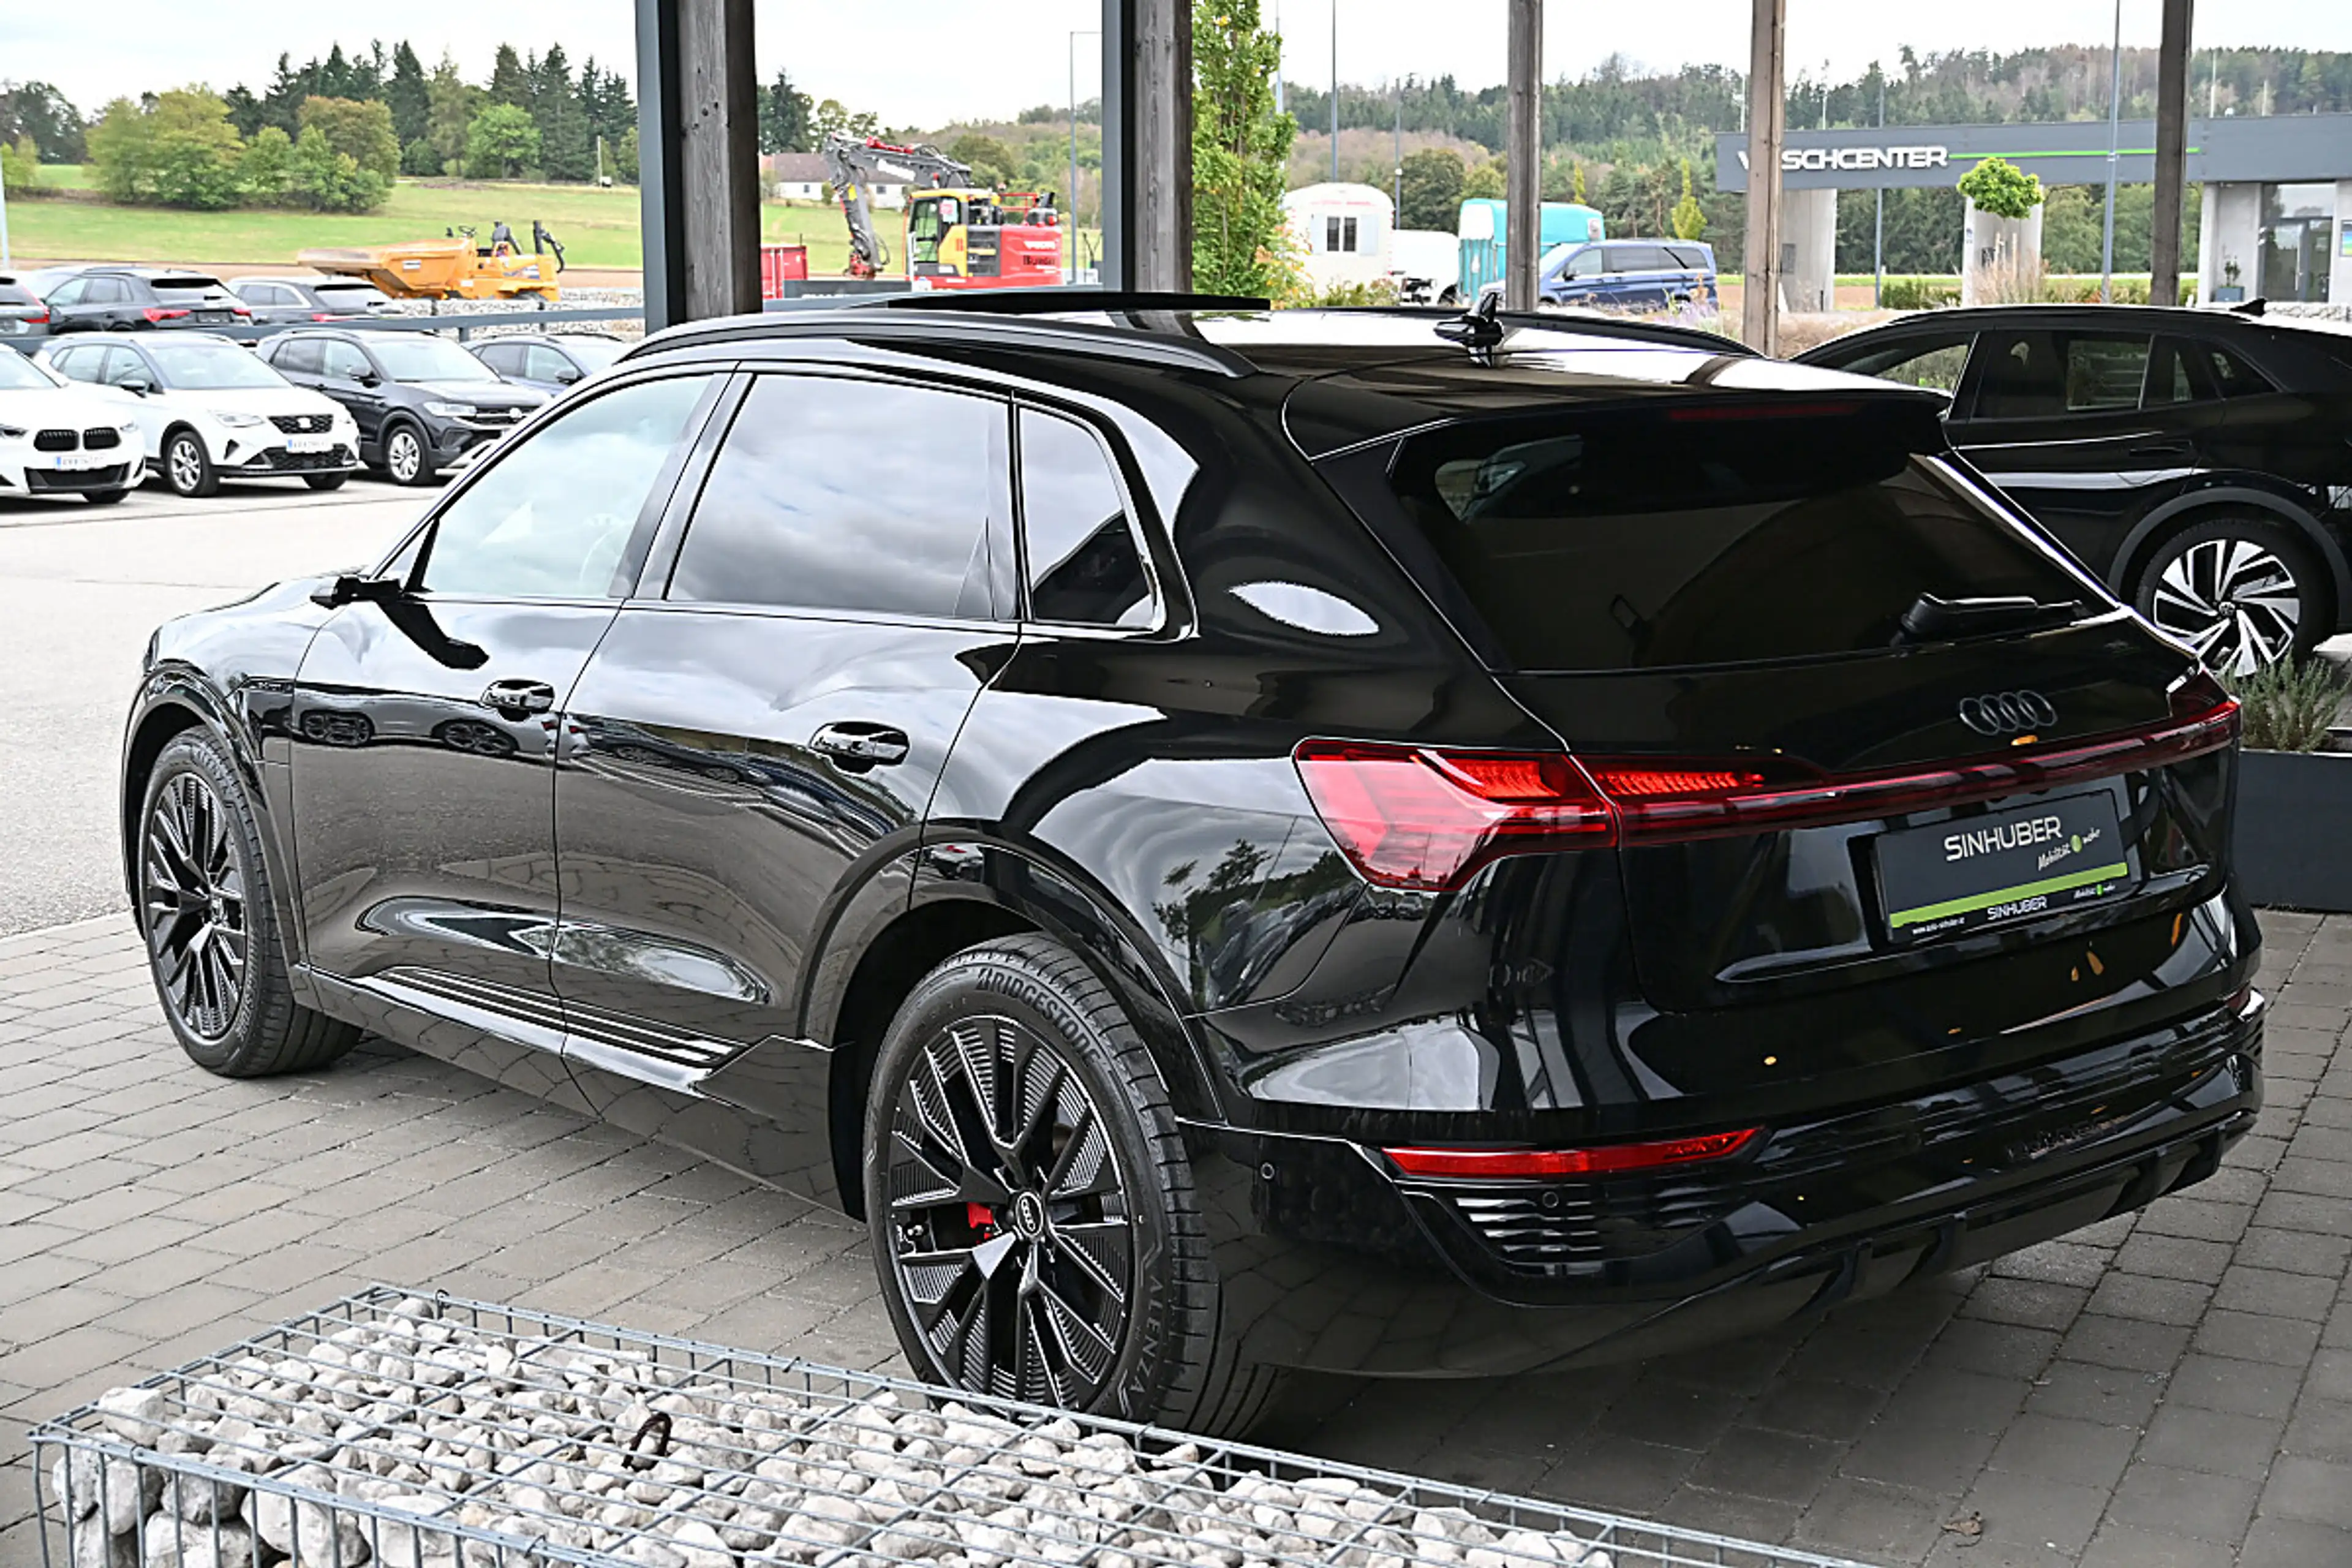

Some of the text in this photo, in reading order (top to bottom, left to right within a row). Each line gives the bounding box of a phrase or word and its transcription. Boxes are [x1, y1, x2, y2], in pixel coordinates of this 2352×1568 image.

[1737, 146, 1948, 170] SCHCENTER
[1943, 815, 2064, 862] SINHUBER
[1987, 895, 2048, 921] SINHUBER
[975, 968, 1101, 1069] BRIDGESTONE
[1129, 1275, 1164, 1393] ALENZA
